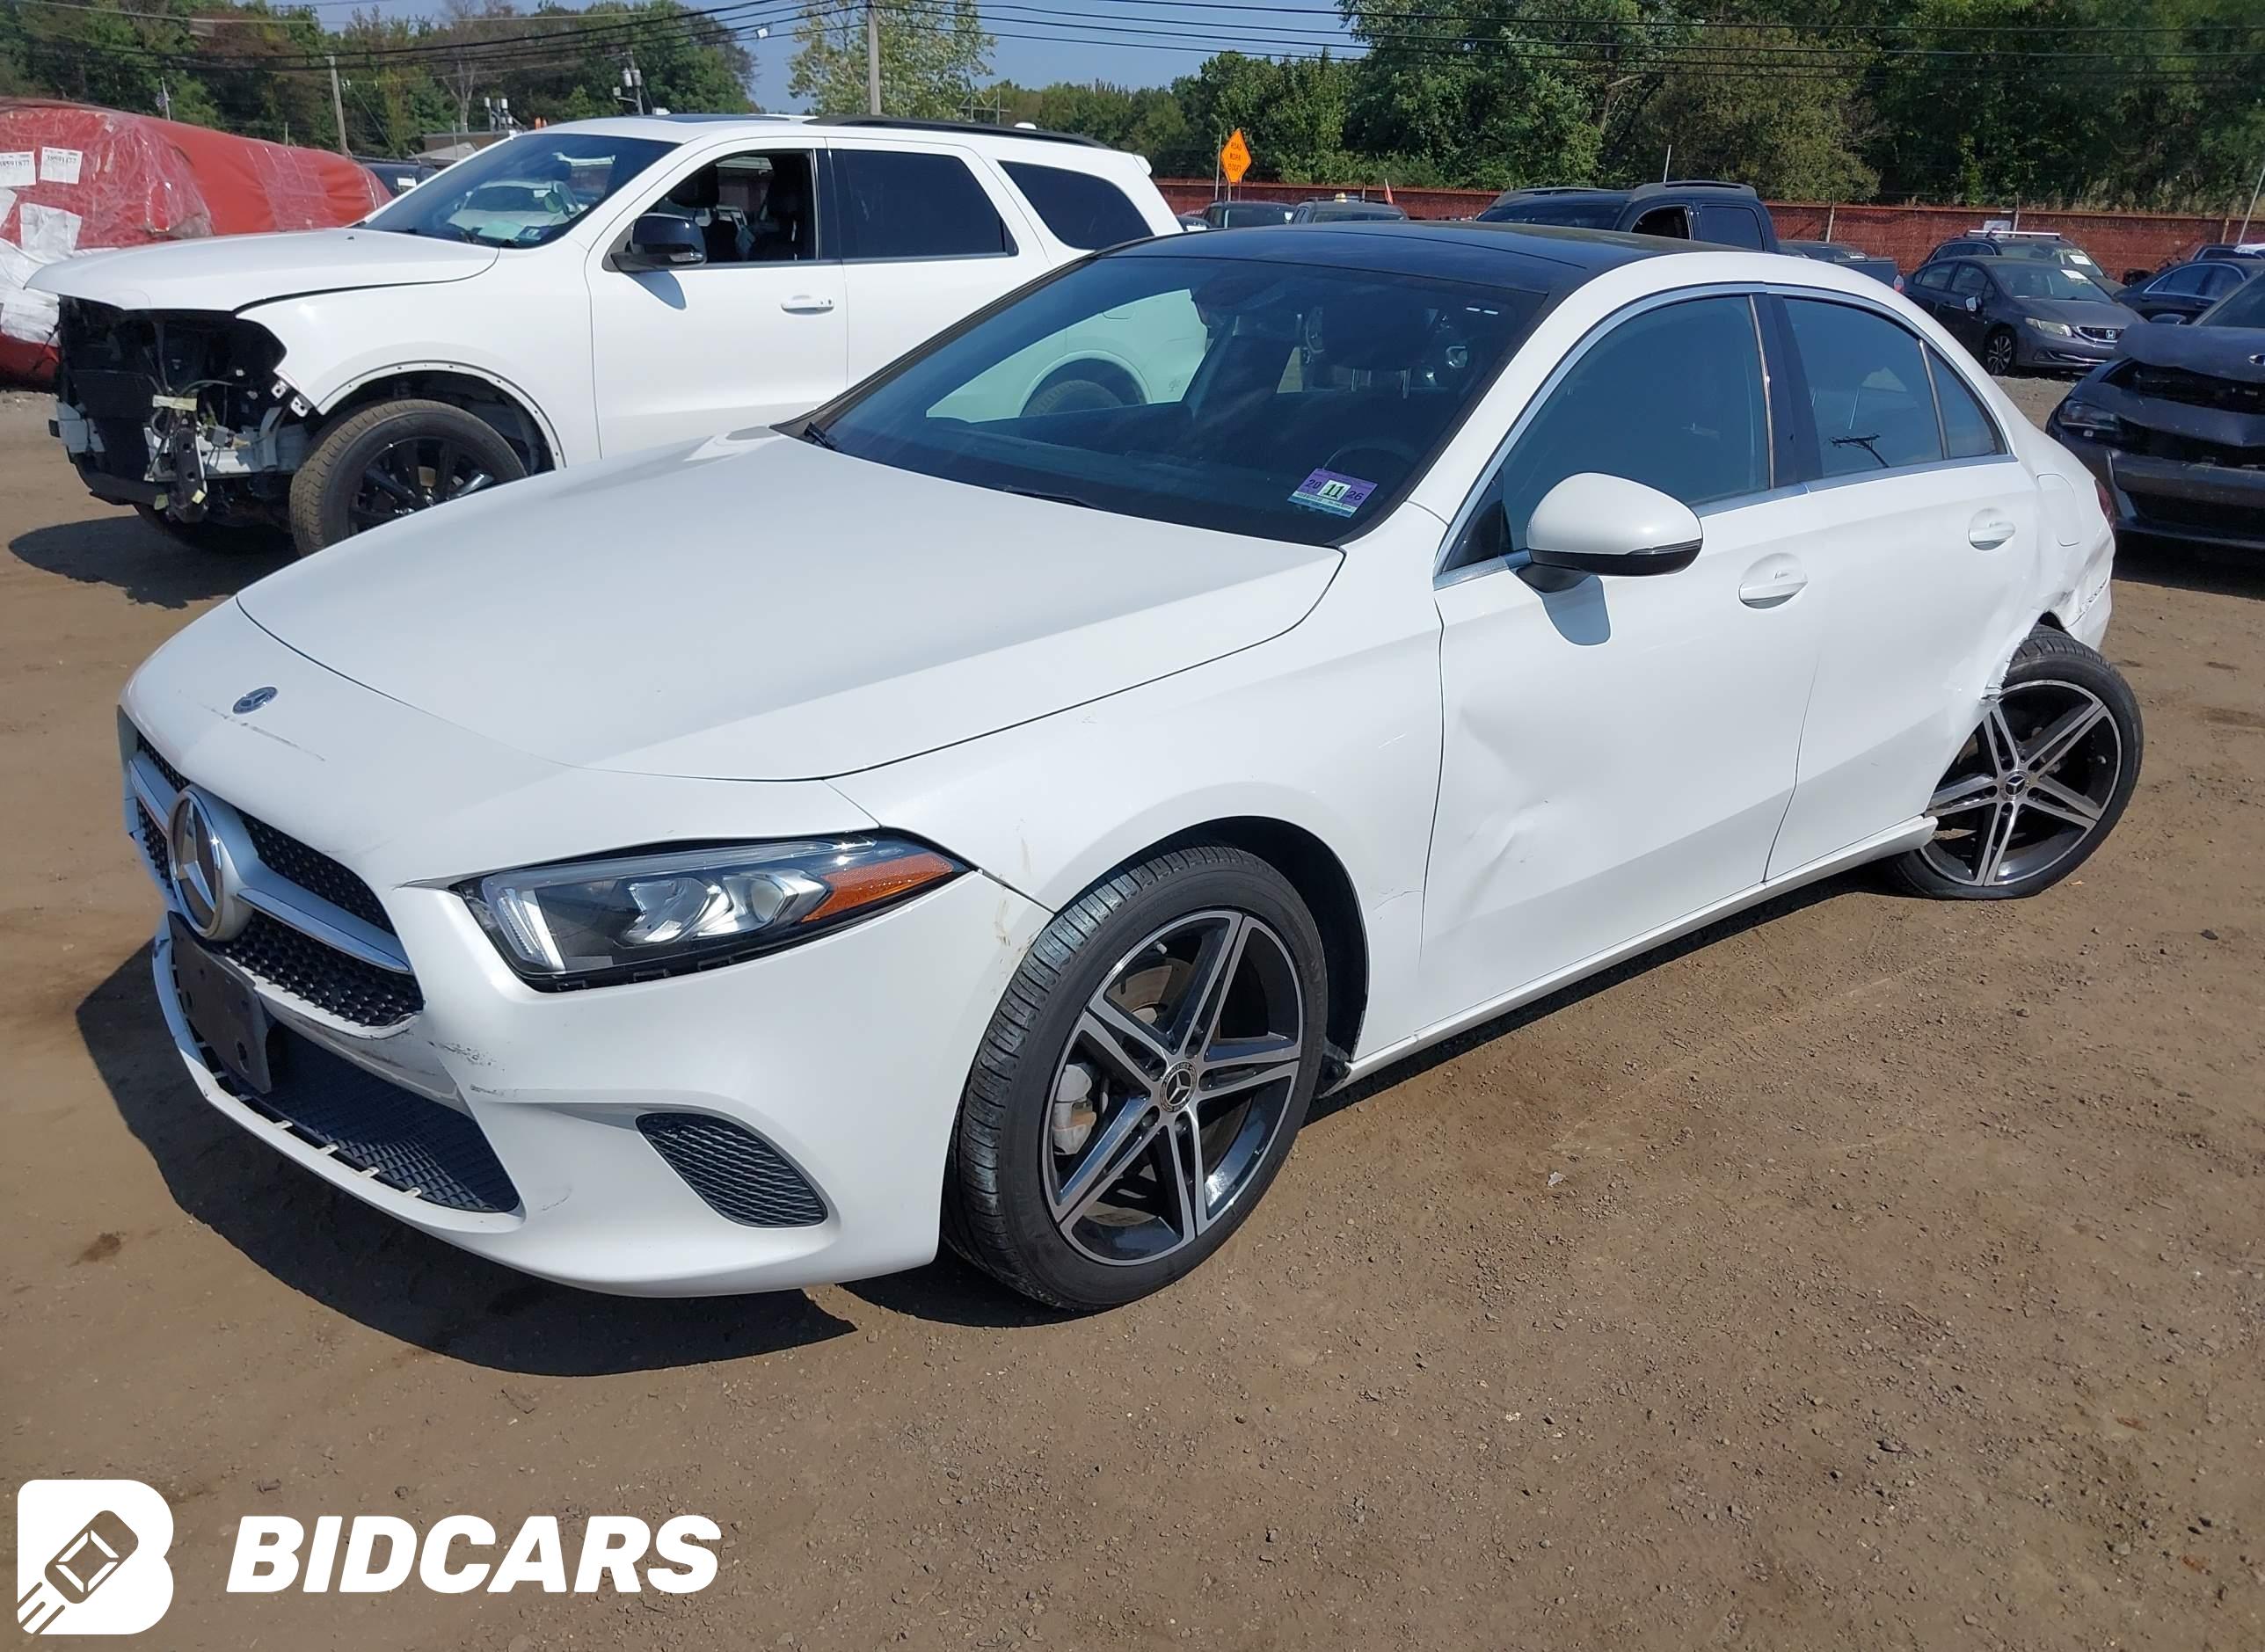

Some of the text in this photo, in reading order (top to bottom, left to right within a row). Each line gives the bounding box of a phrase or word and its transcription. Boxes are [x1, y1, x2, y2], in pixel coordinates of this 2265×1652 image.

[1307, 478, 1364, 501] 20 11 26
